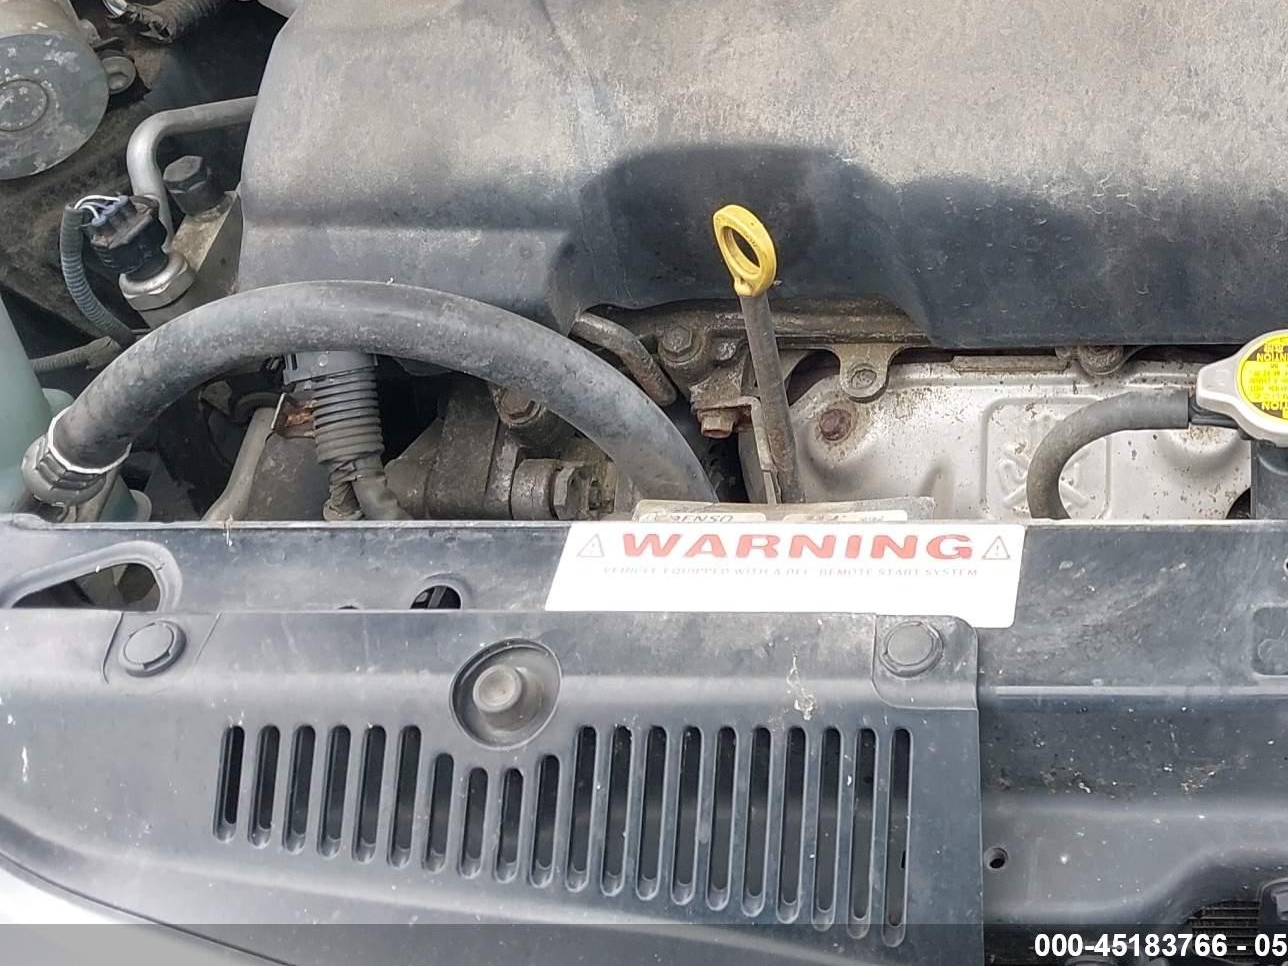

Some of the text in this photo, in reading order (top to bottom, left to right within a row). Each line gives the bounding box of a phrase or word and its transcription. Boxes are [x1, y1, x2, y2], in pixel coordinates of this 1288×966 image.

[622, 533, 973, 560] WARNING
[877, 566, 919, 575] START
[924, 566, 978, 576] SYSTEM
